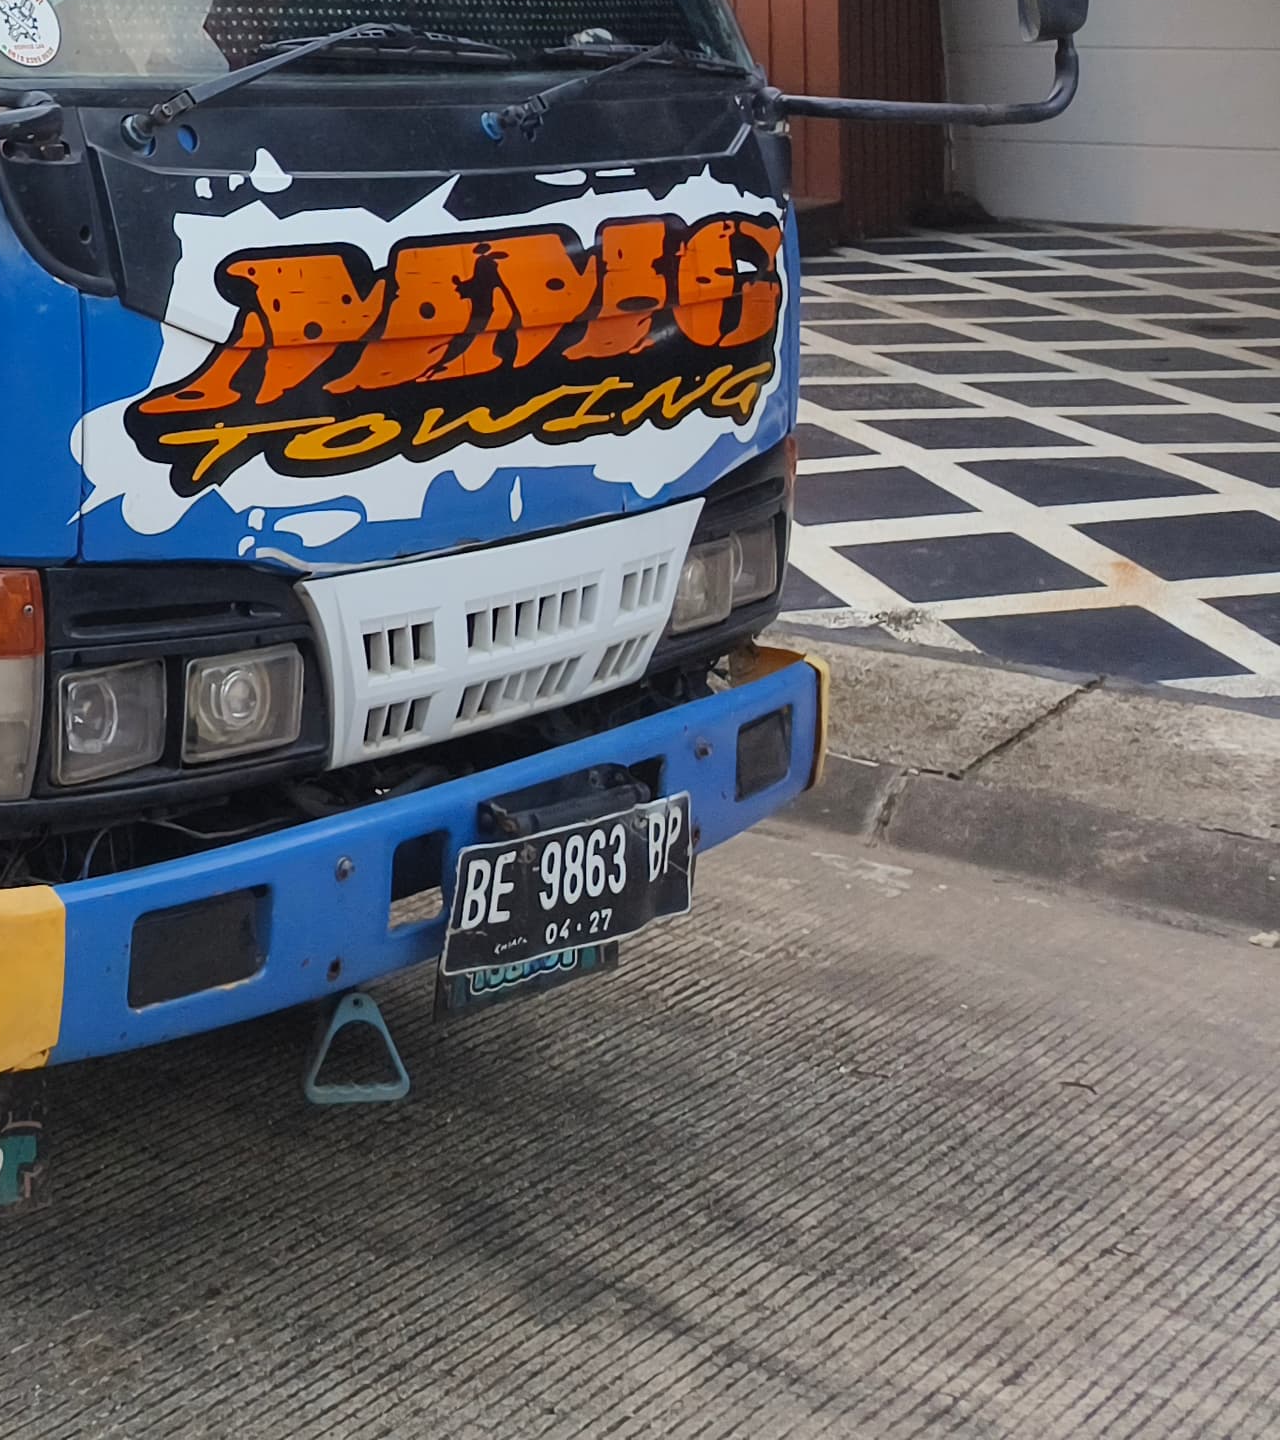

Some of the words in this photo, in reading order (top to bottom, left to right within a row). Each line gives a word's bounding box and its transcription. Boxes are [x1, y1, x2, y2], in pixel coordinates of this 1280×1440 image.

[159, 359, 772, 482] TOWING
[461, 850, 517, 931] BE
[539, 823, 627, 911] 9863
[647, 805, 683, 883] BP
